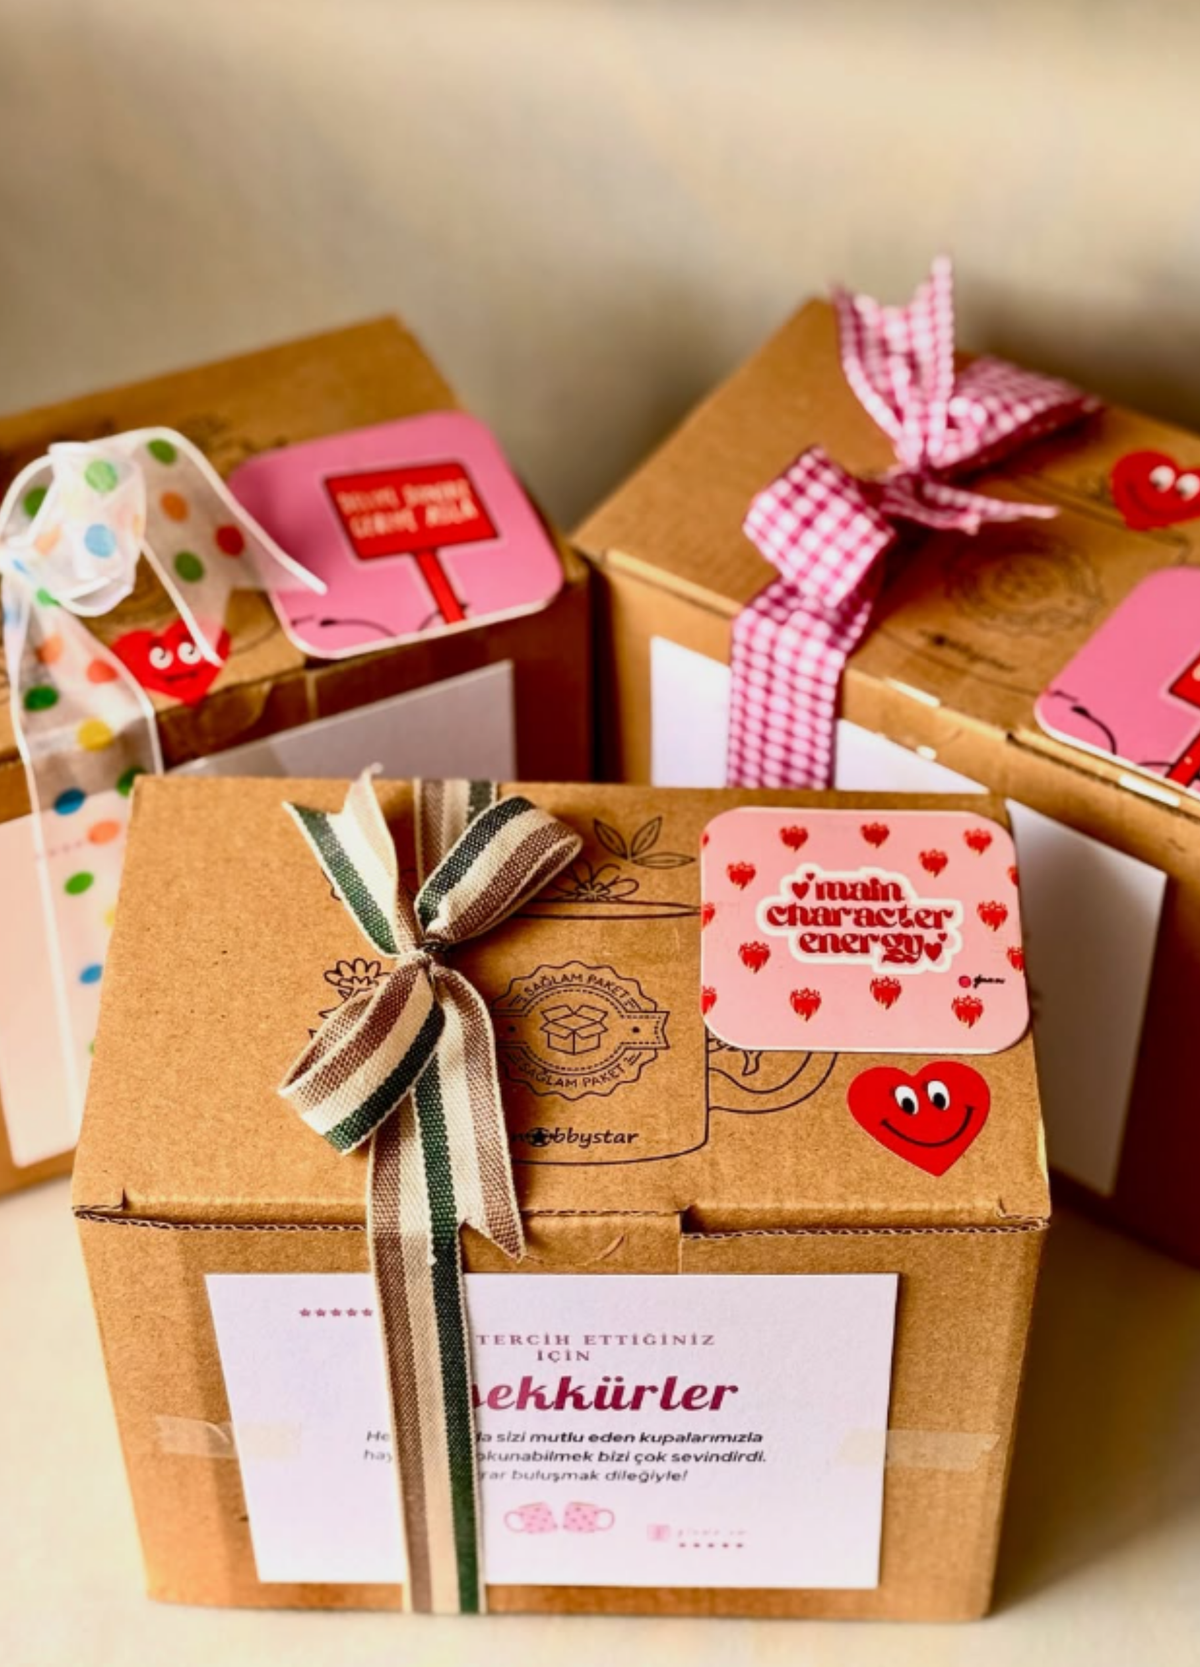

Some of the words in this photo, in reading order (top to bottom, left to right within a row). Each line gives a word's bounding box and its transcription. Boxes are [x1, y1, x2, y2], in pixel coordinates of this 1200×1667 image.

[815, 877, 905, 901] main
[766, 903, 954, 930] character
[799, 932, 926, 963] energy
[524, 974, 583, 995] SAĞLAM
[588, 975, 629, 1000] PAKET
[519, 1062, 578, 1088] SAĞLAM
[582, 1064, 627, 1088] PAKET
[476, 1332, 570, 1345] TERCİH
[584, 1331, 716, 1346] ETTİĞİNİZ
[537, 1349, 591, 1363] İÇİN
[496, 1431, 527, 1443] sizi
[529, 1431, 584, 1443] mutlu
[588, 1432, 636, 1443] eden
[639, 1431, 763, 1446] kupalarımızla
[597, 1451, 630, 1462] bizi
[633, 1450, 668, 1465] çok
[671, 1450, 767, 1463] sevindirdi.
[511, 1470, 599, 1483] buluşmak
[604, 1469, 688, 1484] dileğiyle!
